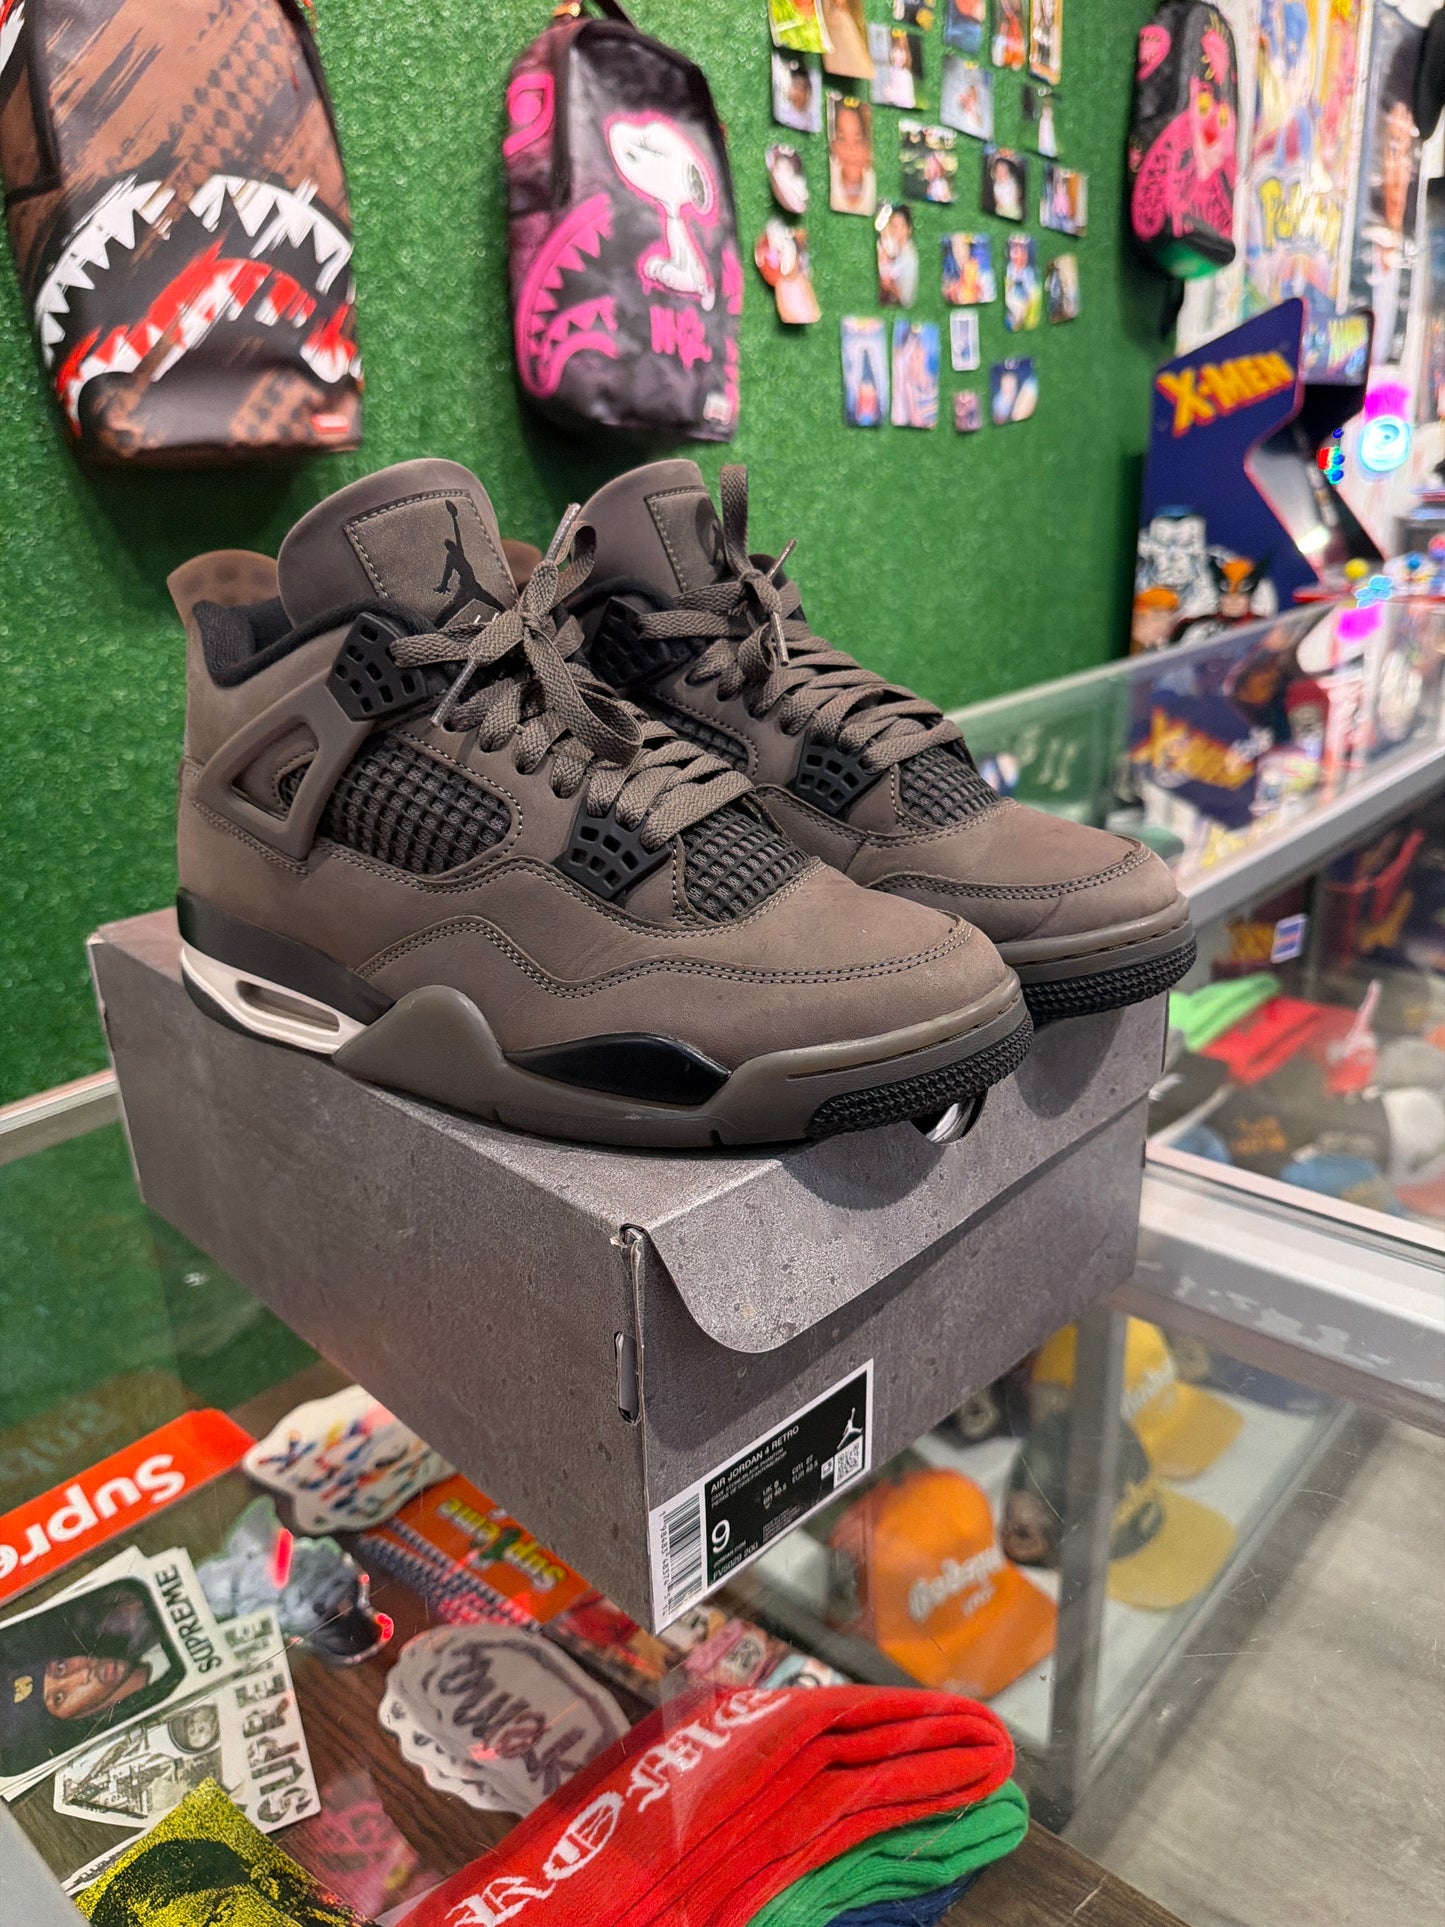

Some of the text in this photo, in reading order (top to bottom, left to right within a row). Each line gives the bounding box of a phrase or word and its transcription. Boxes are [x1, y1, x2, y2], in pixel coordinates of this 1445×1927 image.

[1155, 351, 1295, 438] X-MEN
[711, 1425, 799, 1494] AIR JORDAN 4 RETRO
[660, 1524, 669, 1555] 98483
[711, 1519, 730, 1554] 9
[662, 1560, 671, 1586] 48374
[155, 1563, 223, 1674] SUPREME
